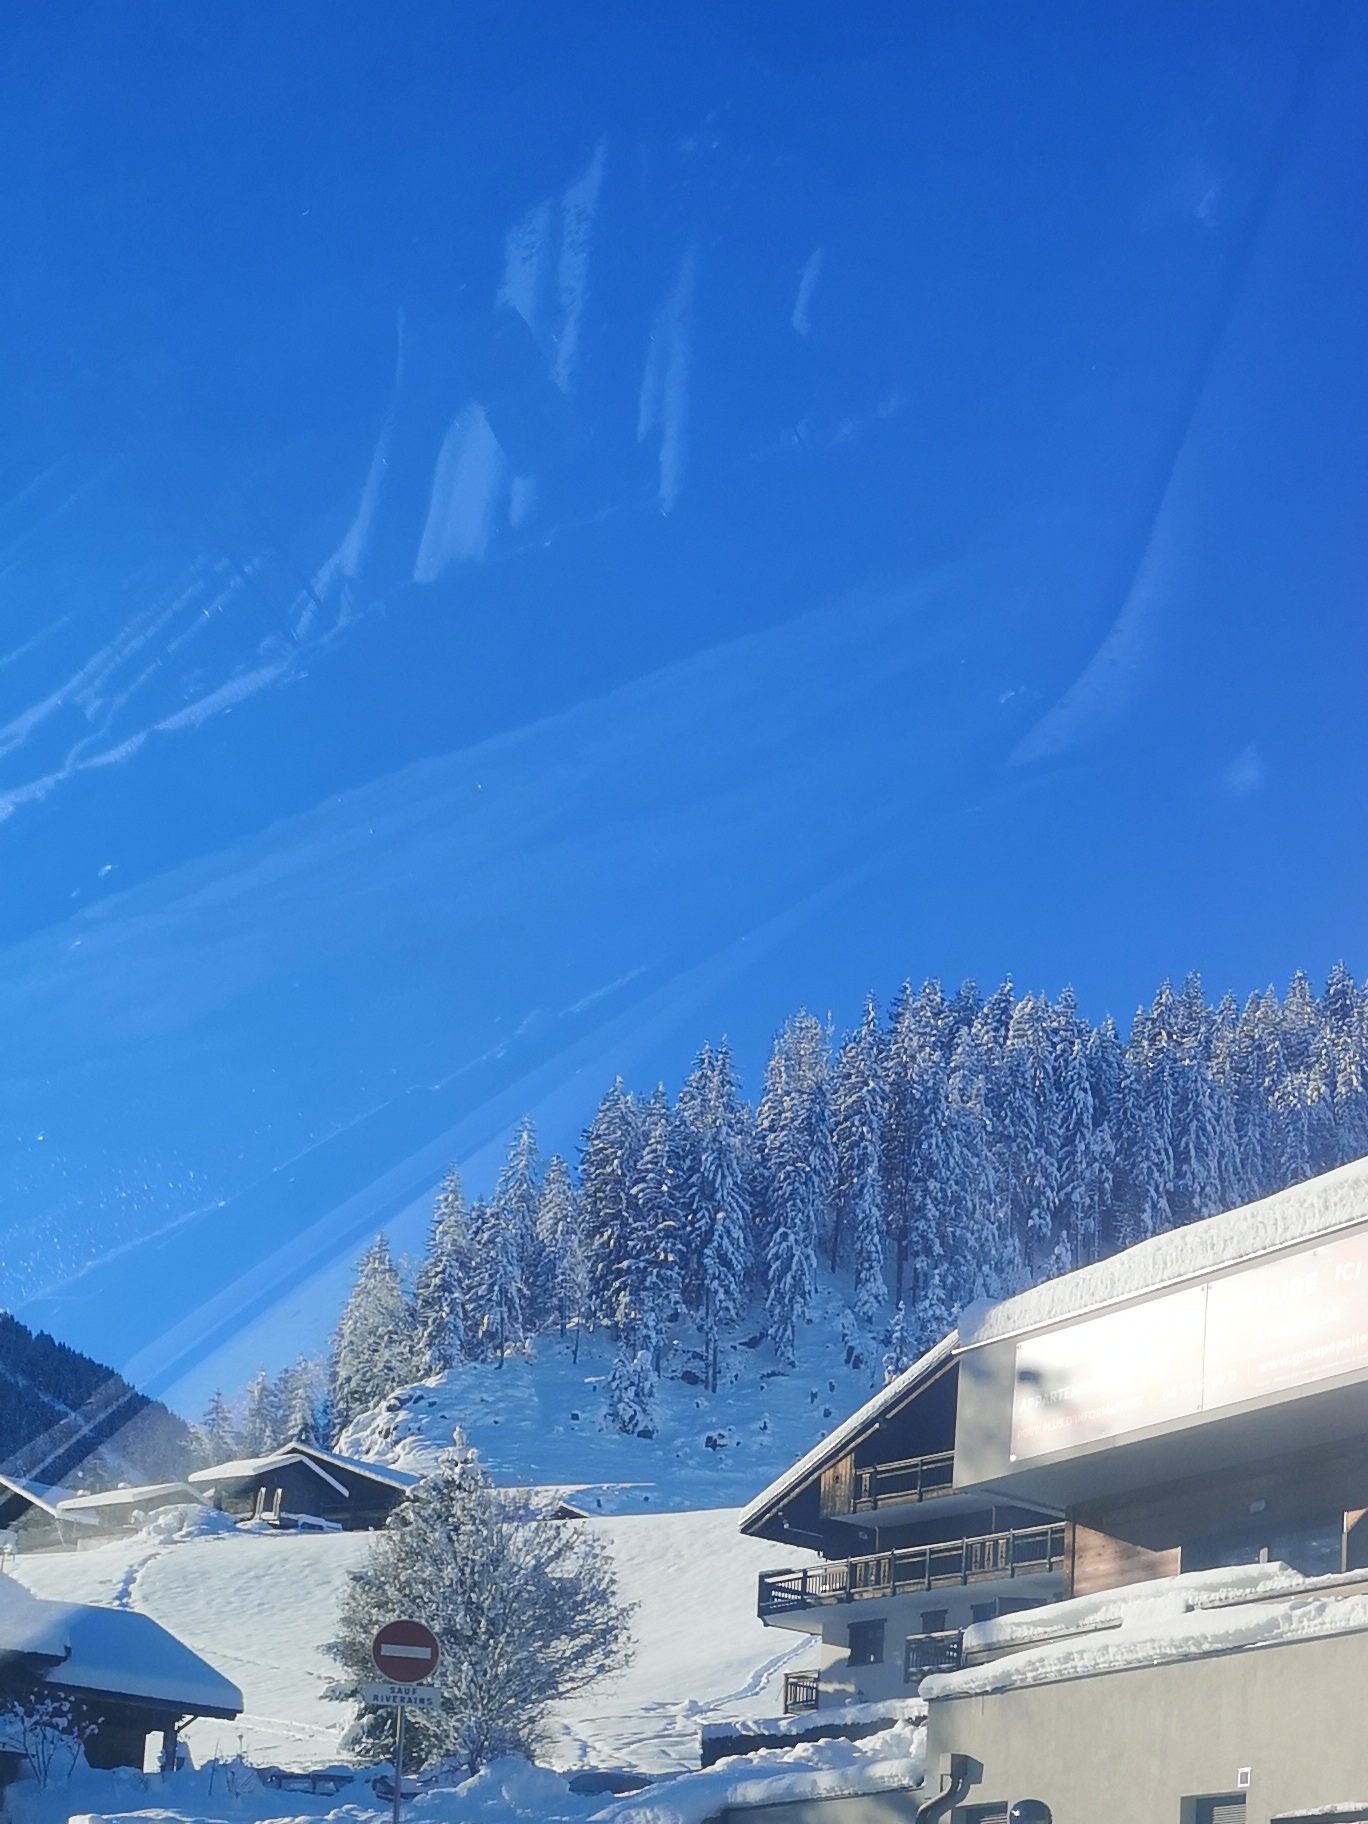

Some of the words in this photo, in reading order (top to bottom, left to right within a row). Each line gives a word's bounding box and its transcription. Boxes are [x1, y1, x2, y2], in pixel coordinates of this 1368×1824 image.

[1334, 1260, 1362, 1282] ICI
[1016, 1424, 1040, 1441] POUR
[1042, 1417, 1064, 1434] PLUS
[389, 1686, 417, 1695] SAUF
[372, 1694, 433, 1706] RIVERAINS
